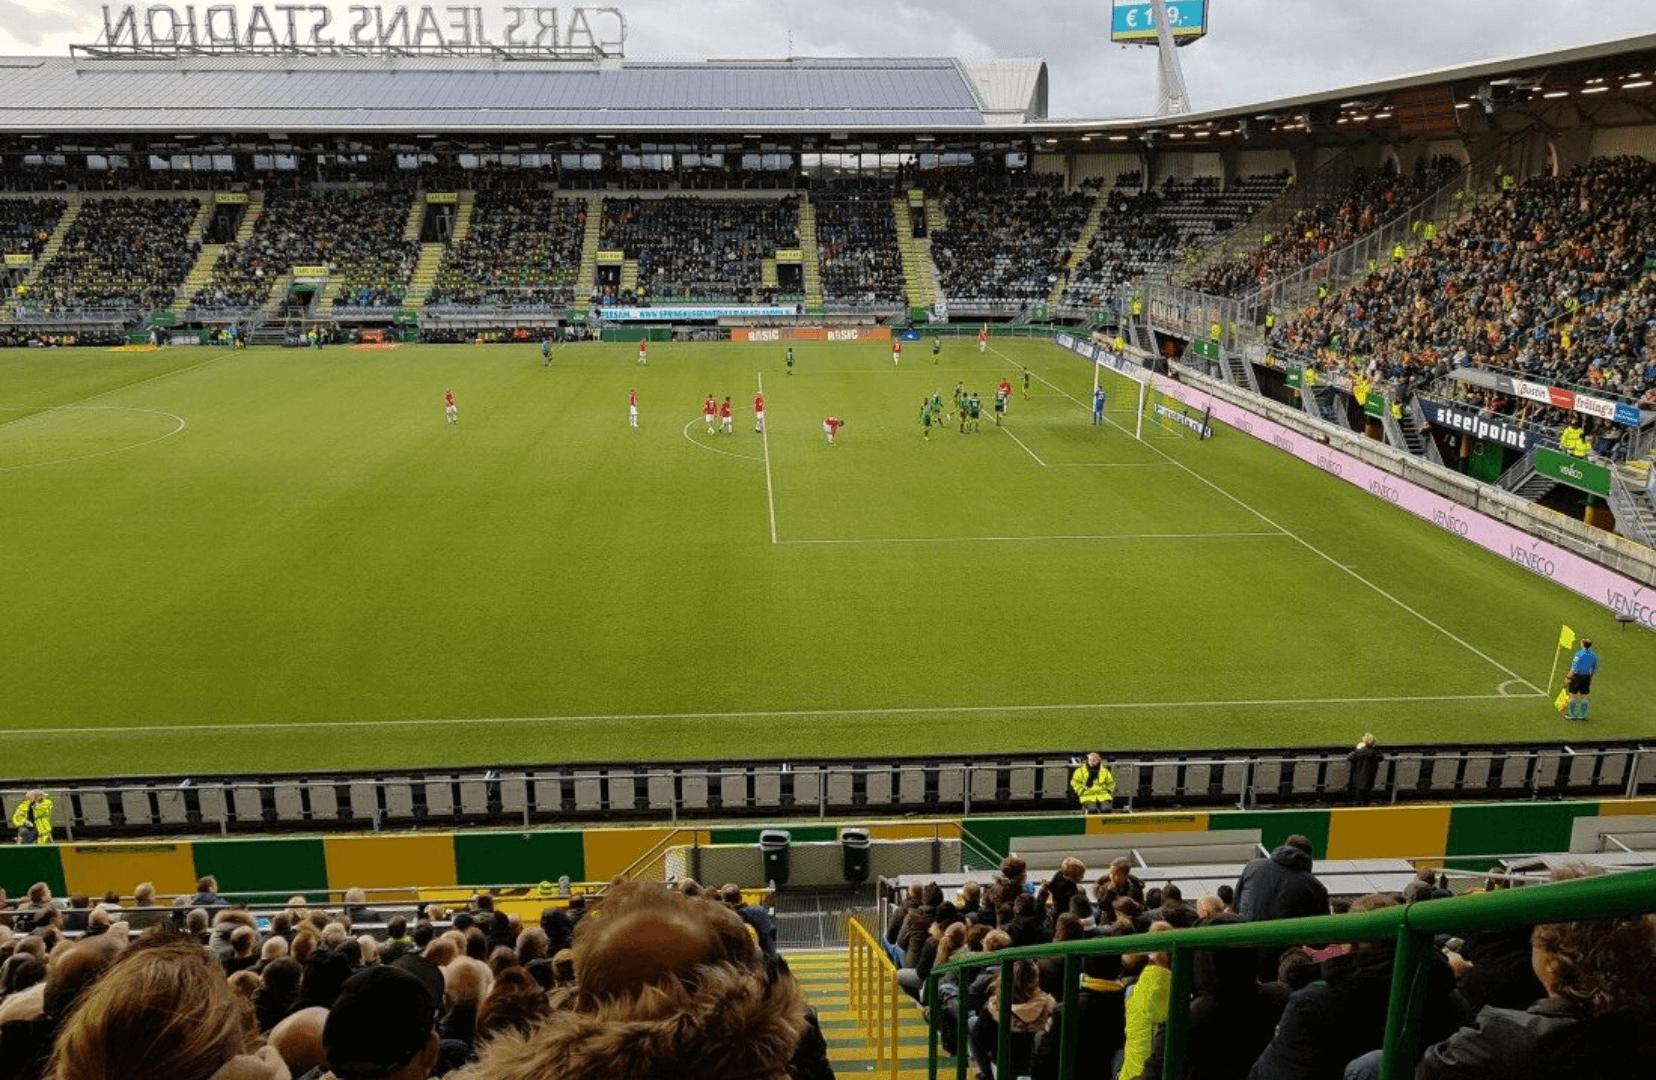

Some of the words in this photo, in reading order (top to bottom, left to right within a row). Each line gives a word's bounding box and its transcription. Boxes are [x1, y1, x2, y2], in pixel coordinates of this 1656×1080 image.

[1437, 408, 1526, 448] steelpoint
[1369, 479, 1399, 503] VENECO
[1432, 507, 1469, 536] VENECO
[1510, 543, 1555, 576] VENECO
